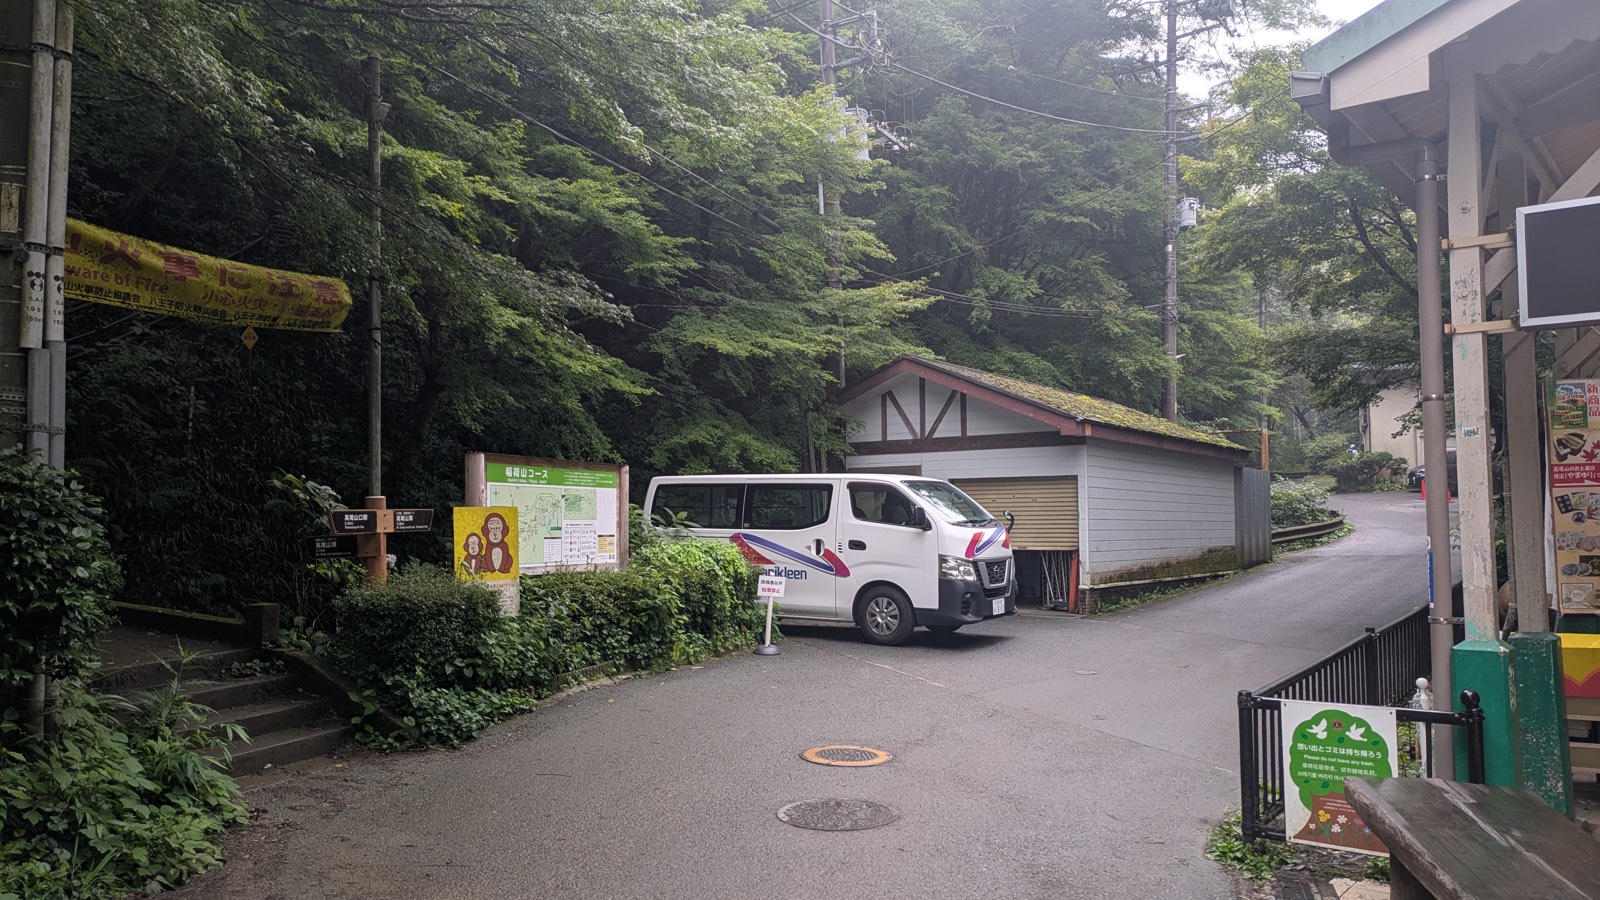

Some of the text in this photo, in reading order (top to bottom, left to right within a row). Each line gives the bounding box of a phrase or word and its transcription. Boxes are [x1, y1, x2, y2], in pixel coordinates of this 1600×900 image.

[114, 274, 131, 287] of
[135, 276, 170, 294] Fire
[1587, 383, 1600, 417] 新商品
[505, 466, 549, 479] 稲荷山コース
[1297, 742, 1382, 759] 想い出とゴミは持ち帰ろう
